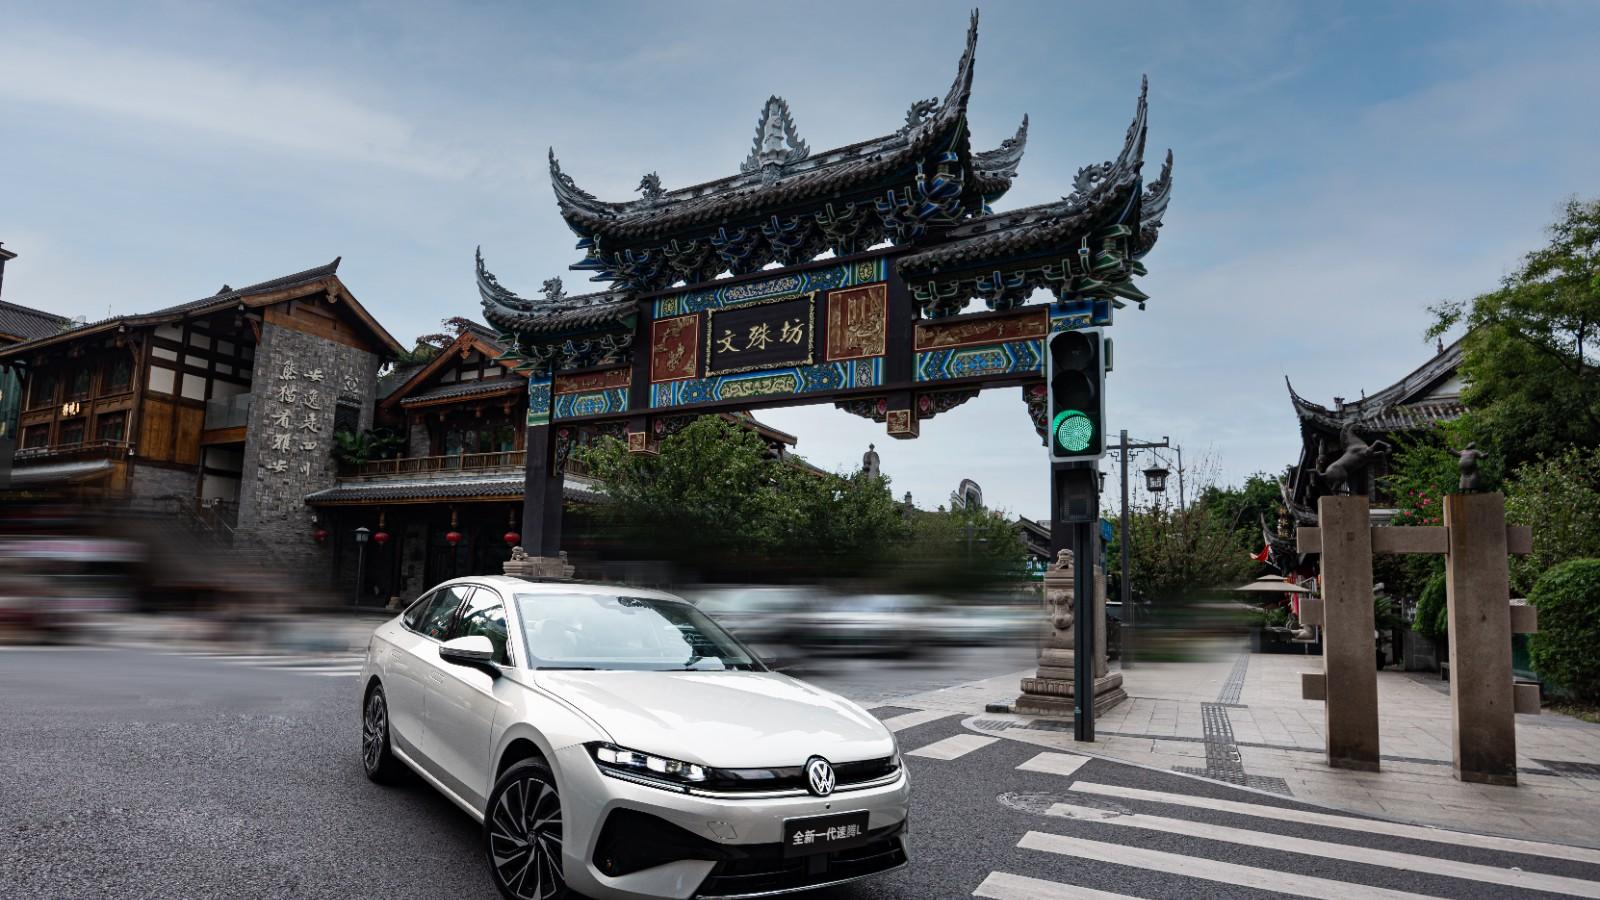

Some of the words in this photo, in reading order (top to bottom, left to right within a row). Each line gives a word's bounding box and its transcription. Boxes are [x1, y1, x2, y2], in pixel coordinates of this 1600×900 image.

[716, 318, 805, 353] 文殊坊
[792, 824, 862, 846] 全新一代速腾L
